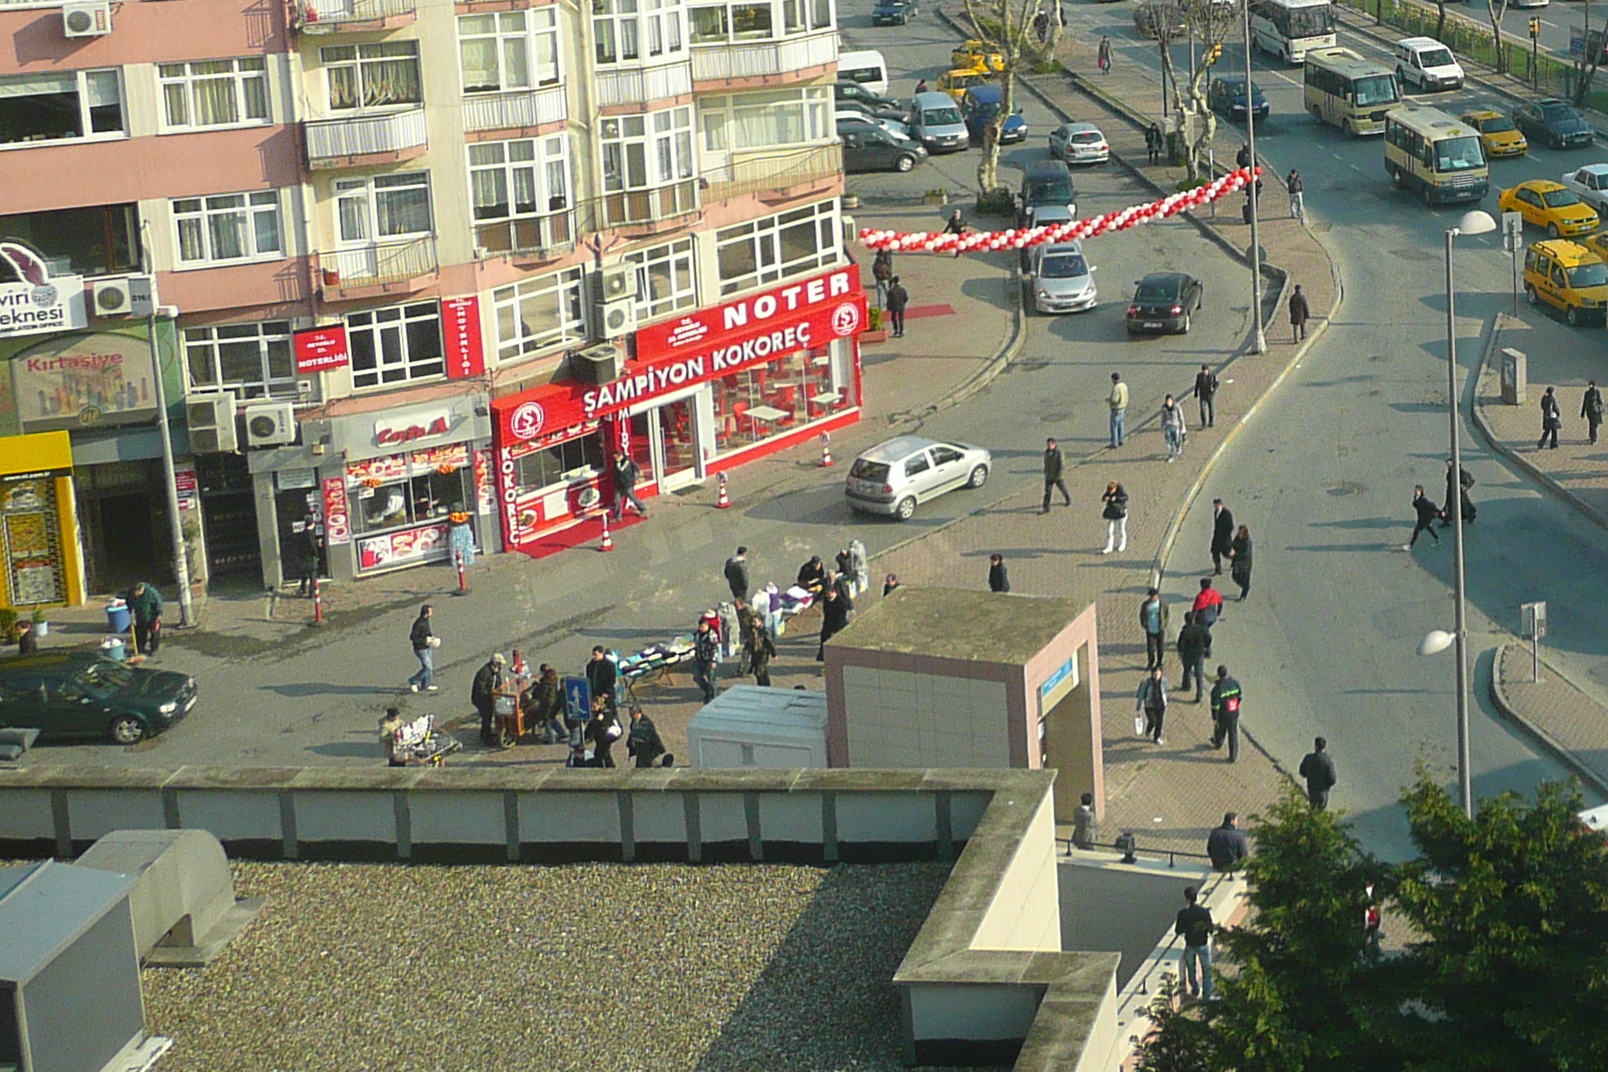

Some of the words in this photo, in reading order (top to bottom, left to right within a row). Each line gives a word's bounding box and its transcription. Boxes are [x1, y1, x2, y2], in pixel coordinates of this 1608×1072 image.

[0, 304, 64, 326] eknesi
[723, 272, 850, 330] NOTER
[27, 352, 124, 373] Kırtaşiye
[583, 356, 704, 418] ŞAMPİYON
[712, 321, 811, 371] KOKOREÇ
[501, 447, 522, 547] KOKOREÇ
